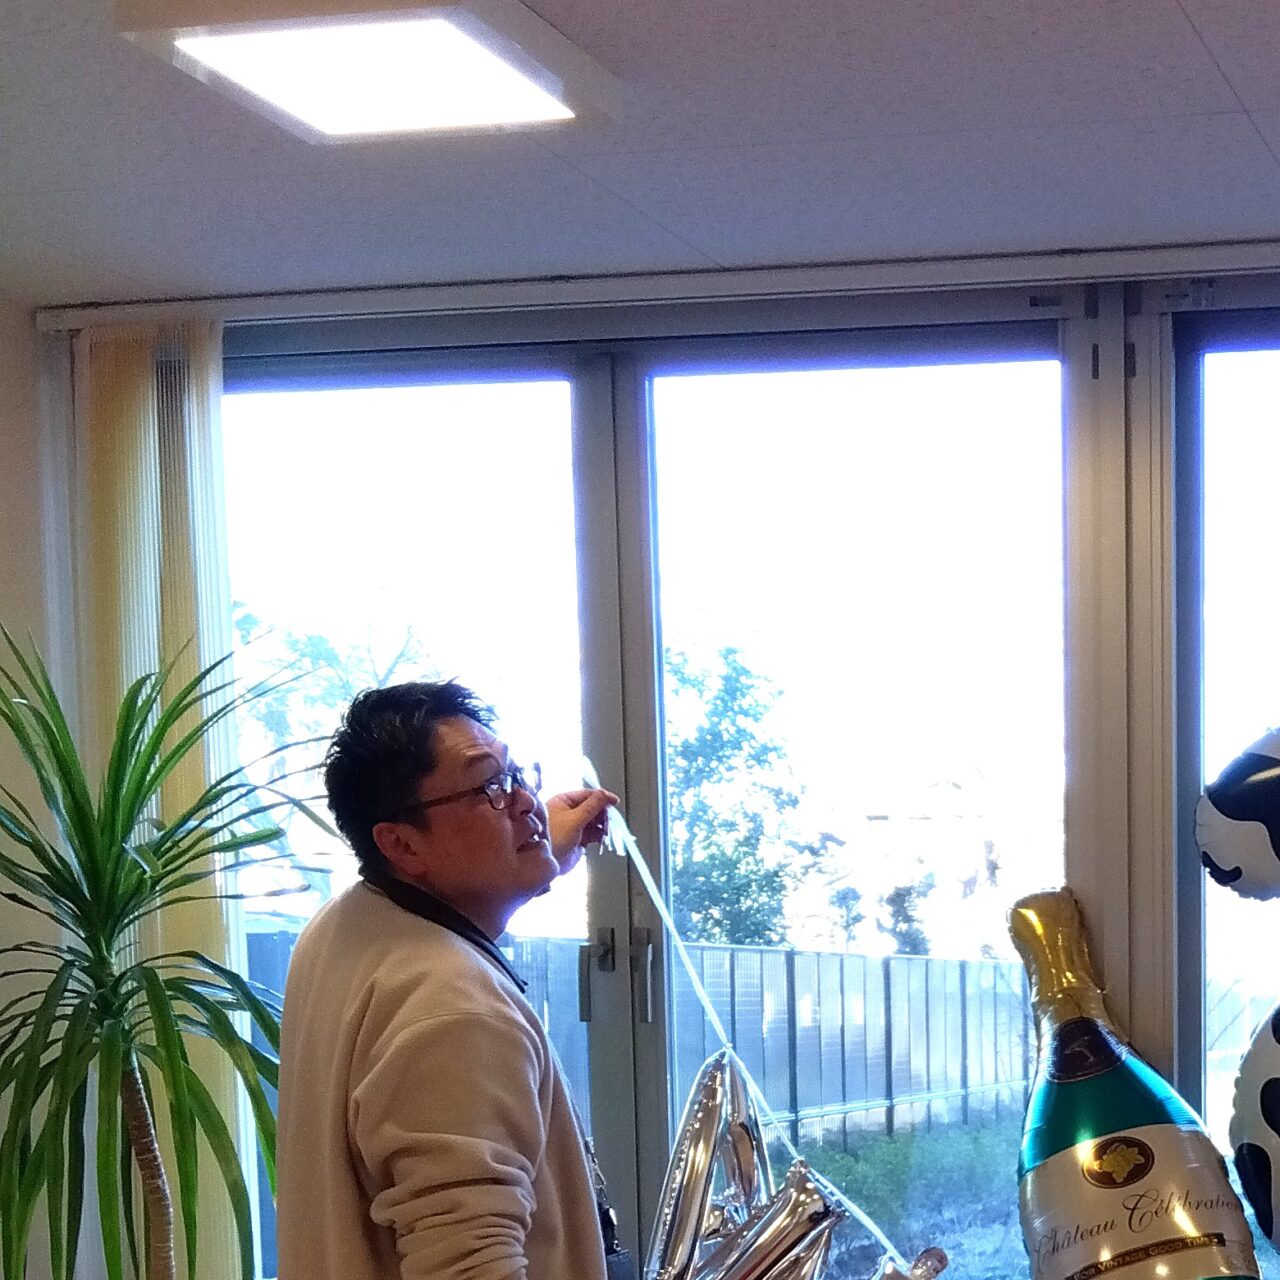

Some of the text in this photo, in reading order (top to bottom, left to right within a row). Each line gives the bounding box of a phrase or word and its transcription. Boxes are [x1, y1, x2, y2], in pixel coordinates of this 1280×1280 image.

[1122, 1188, 1239, 1233] Célbration
[1097, 1251, 1146, 1271] VINTAGE
[1148, 1241, 1182, 1256] GOOD
[1186, 1236, 1218, 1247] TIME
